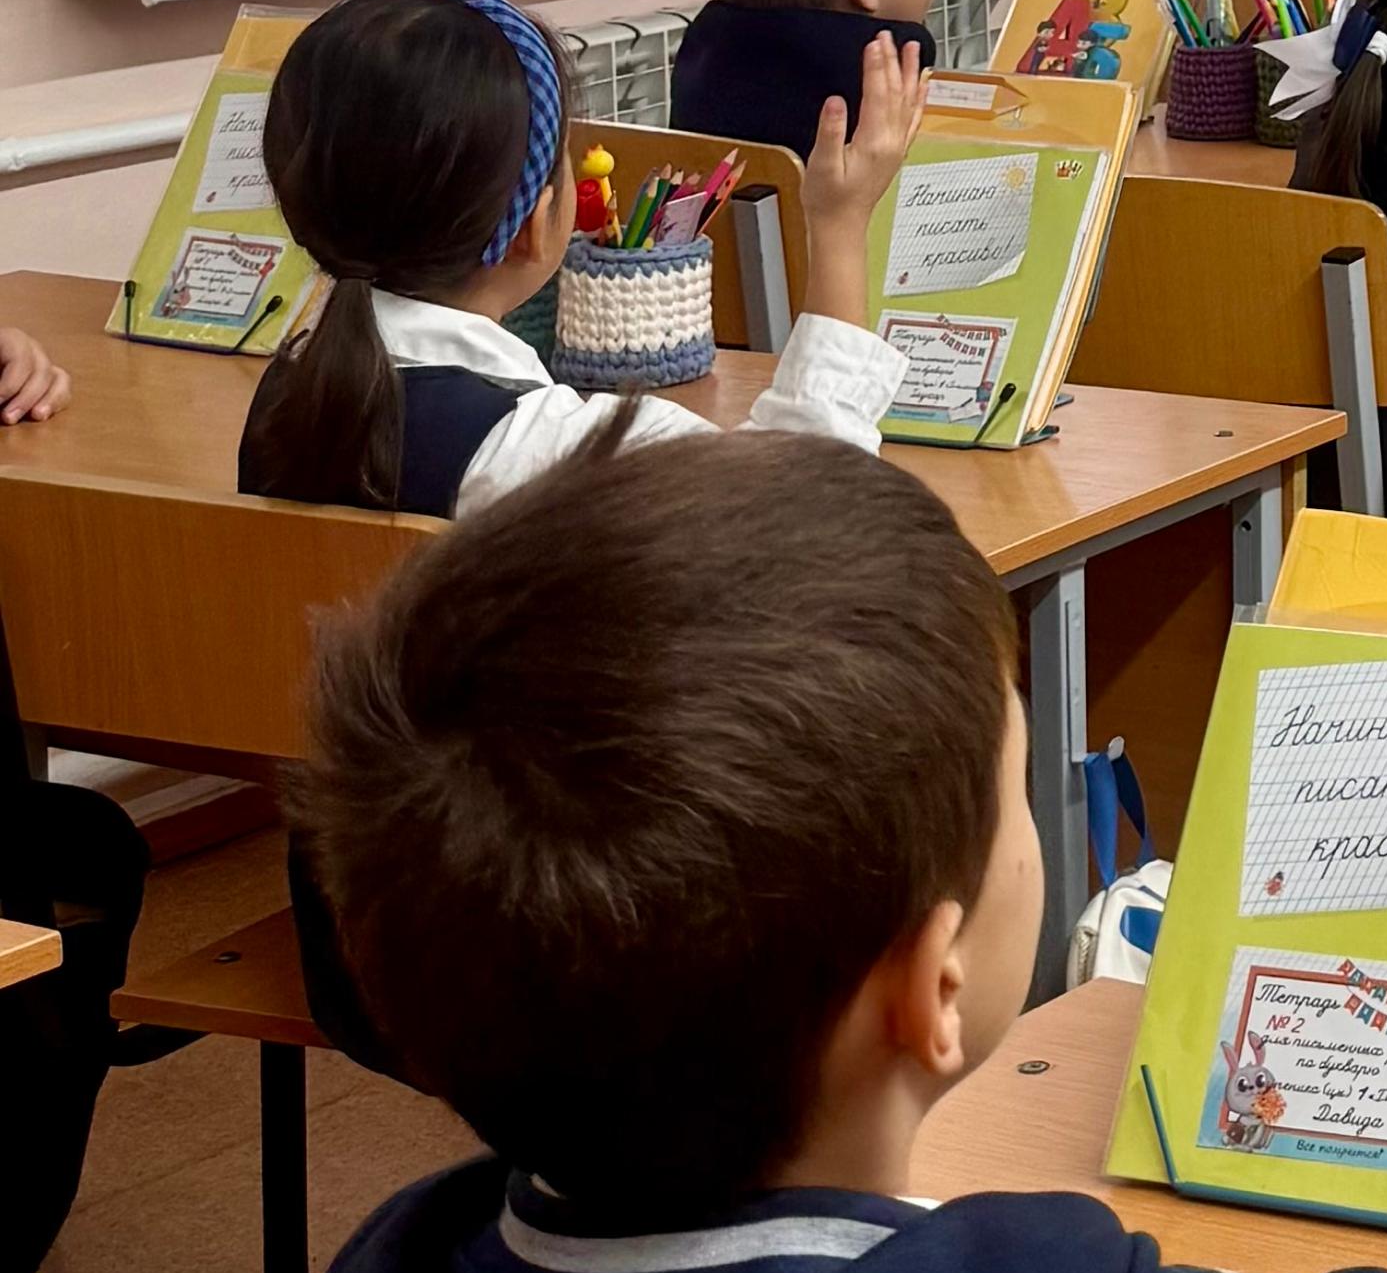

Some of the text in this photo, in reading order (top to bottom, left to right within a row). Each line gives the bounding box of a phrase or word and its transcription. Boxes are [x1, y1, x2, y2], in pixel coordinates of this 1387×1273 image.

[904, 182, 997, 208] Начинаю
[914, 221, 988, 238] писать
[921, 234, 1016, 274] красиво!
[1255, 983, 1341, 1018] Тетрадь
[1266, 1015, 1305, 1033] № 2
[1260, 1033, 1291, 1049] для
[1296, 1055, 1381, 1081] по букварю
[1312, 1103, 1385, 1135] Давида
